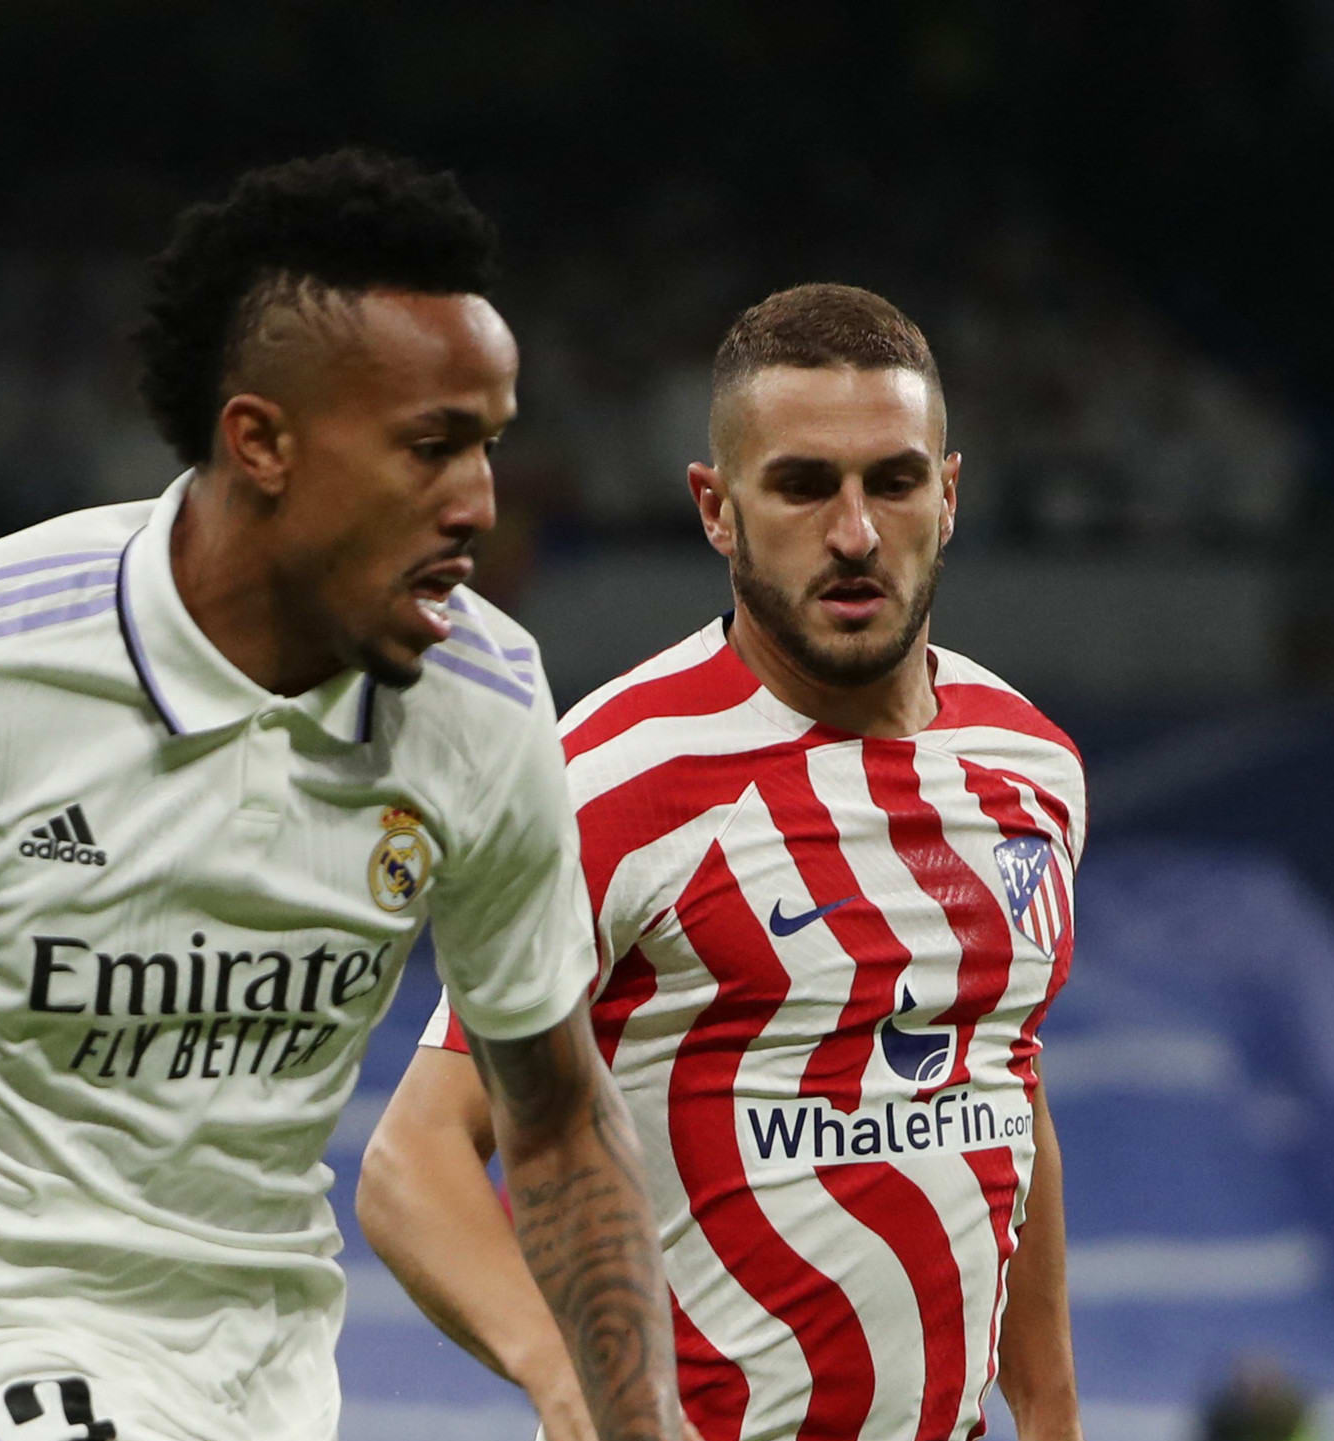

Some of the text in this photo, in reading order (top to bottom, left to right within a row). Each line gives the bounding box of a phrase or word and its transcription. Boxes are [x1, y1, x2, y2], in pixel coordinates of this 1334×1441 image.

[19, 839, 107, 867] adidas
[29, 931, 393, 1016] Emirates
[69, 1014, 340, 1080] FLY BETTER
